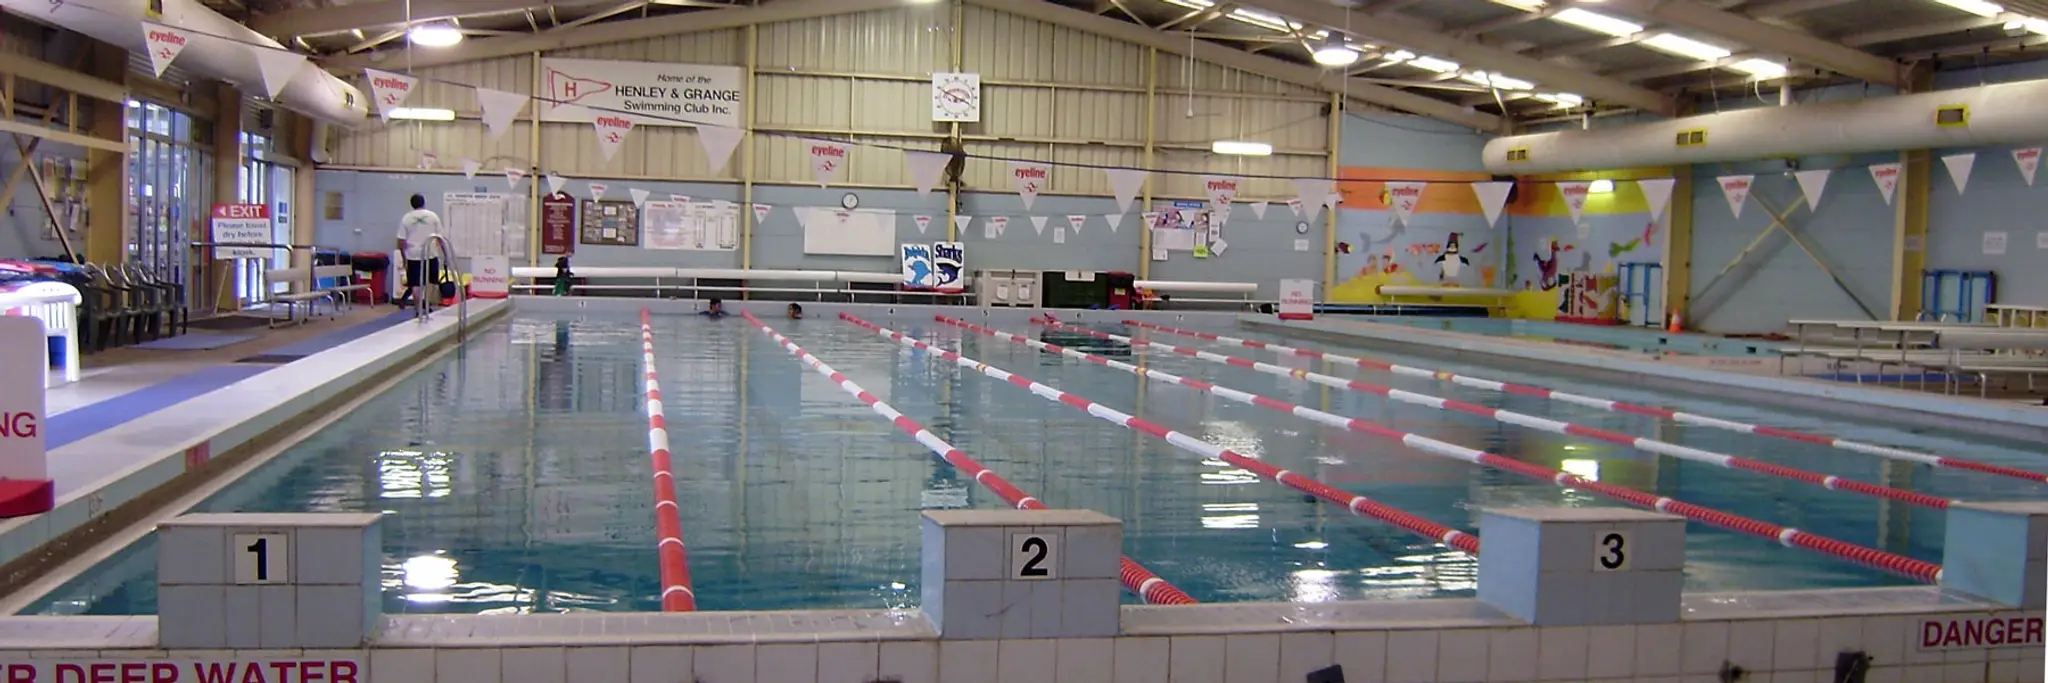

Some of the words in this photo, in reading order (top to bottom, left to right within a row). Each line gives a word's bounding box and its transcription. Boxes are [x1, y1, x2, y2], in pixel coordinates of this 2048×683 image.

[149, 30, 186, 46] eyeline
[373, 77, 409, 91] eyeline
[657, 74, 684, 82] Home
[685, 75, 696, 83] of
[697, 76, 712, 84] the
[565, 82, 577, 97] H
[615, 85, 667, 98] HENLEY
[671, 88, 680, 99] &
[684, 88, 740, 101] GRANGE
[624, 100, 681, 114] Swimming
[684, 103, 709, 113] Club
[712, 104, 731, 115] Inc.
[597, 116, 632, 129] eyeline
[811, 145, 845, 157] eyeline
[1015, 167, 1046, 178] eyeline
[1207, 180, 1236, 191] eyeline
[230, 204, 262, 218] EXIT
[935, 244, 963, 264] Sharks
[1020, 537, 1048, 576] 2
[1600, 533, 1625, 569] 3
[247, 538, 267, 580] 1
[1923, 617, 2044, 647] DANGER
[56, 663, 179, 683] DEEP
[194, 661, 358, 683] WATER
